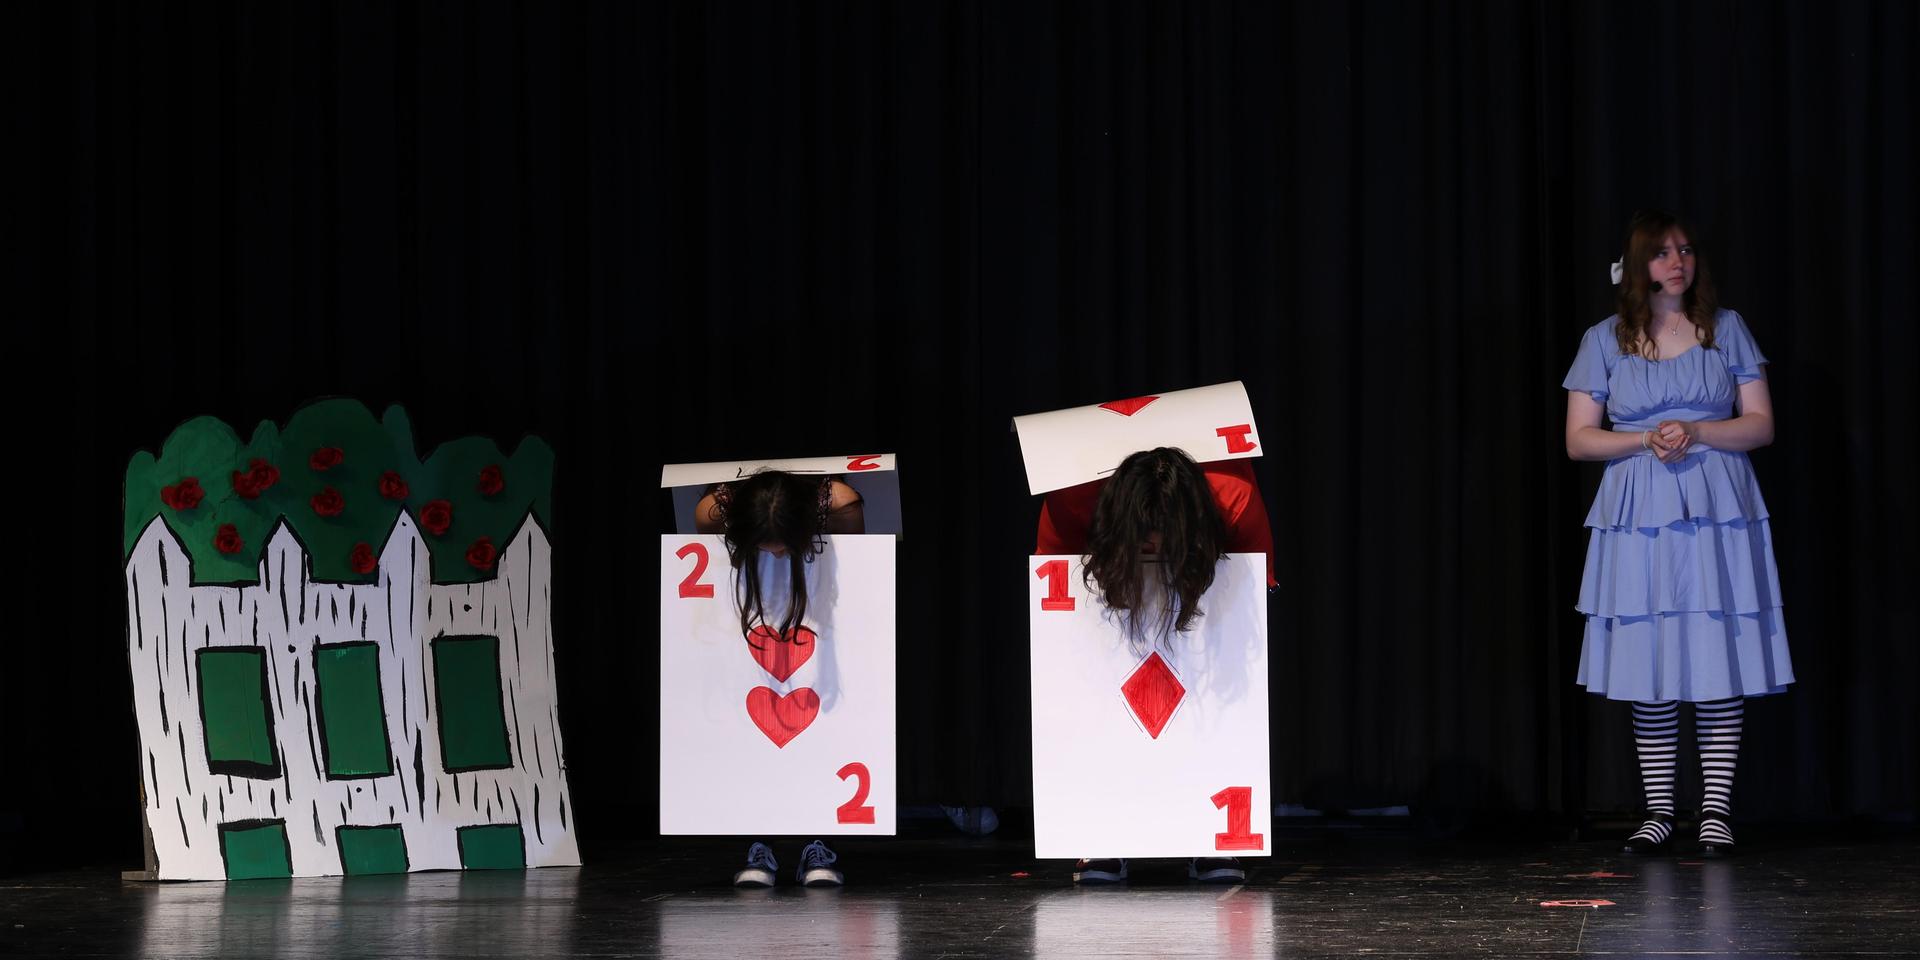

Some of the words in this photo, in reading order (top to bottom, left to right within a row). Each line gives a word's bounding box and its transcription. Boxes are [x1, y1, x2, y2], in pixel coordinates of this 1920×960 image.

[847, 455, 881, 471] 2
[1216, 423, 1257, 454] 1
[676, 542, 715, 599] 2
[1035, 560, 1075, 611] 1
[836, 762, 876, 824] 2
[1210, 786, 1264, 851] 1
